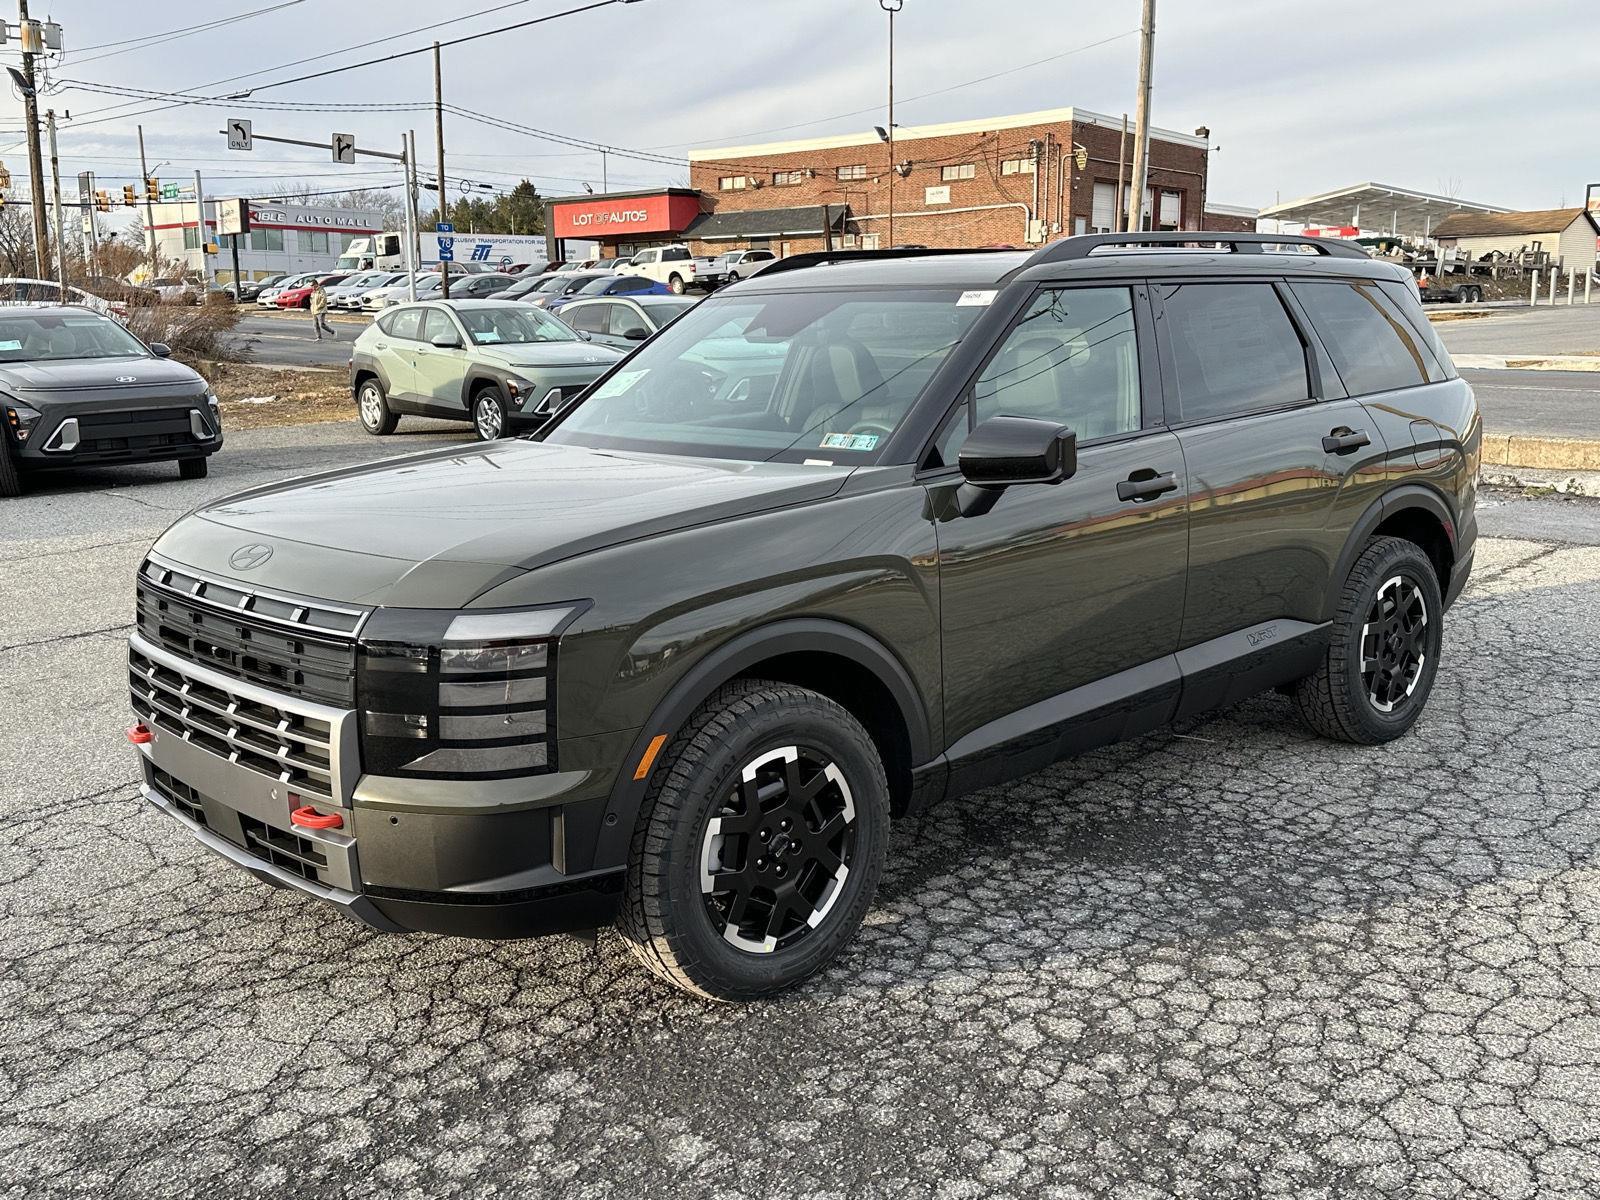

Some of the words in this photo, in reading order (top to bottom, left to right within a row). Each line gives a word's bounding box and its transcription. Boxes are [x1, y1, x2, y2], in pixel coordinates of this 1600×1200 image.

[231, 140, 249, 149] ONLY
[248, 210, 286, 223] XIBLE
[296, 215, 332, 225] AUTO
[336, 217, 372, 228] MALL
[573, 213, 594, 226] LOT
[595, 212, 609, 225] OF
[610, 210, 648, 224] AUTOS
[440, 238, 451, 249] 78
[1246, 625, 1277, 647] XRT
